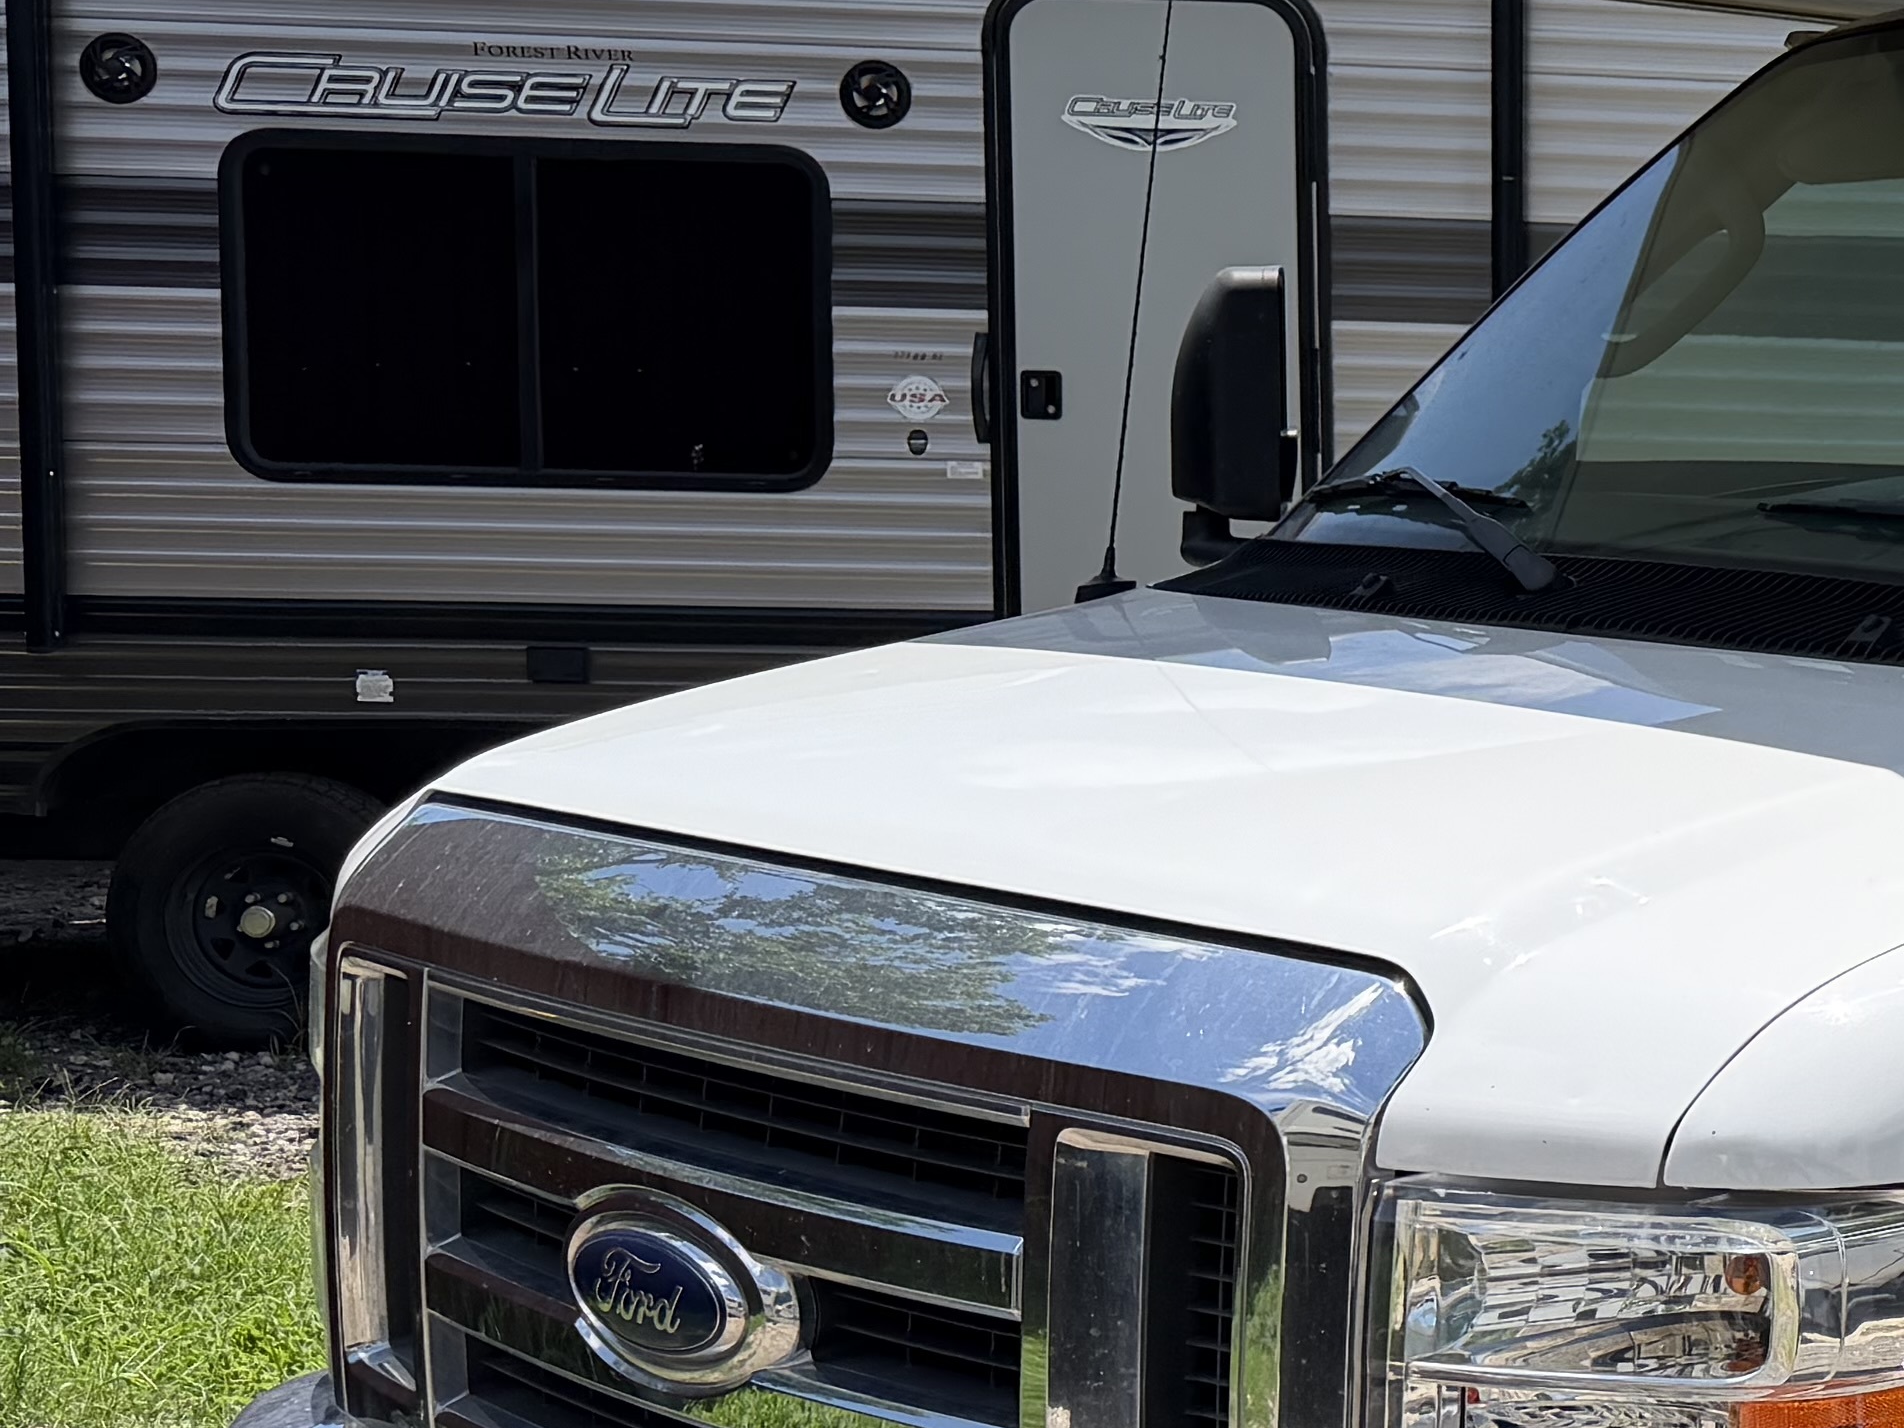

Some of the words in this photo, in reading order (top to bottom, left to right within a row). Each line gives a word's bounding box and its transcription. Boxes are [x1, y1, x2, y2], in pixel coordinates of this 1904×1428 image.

[473, 40, 561, 60] FOREST
[565, 44, 635, 62] RIVER
[889, 392, 947, 404] USA
[595, 1247, 683, 1334] Ford
